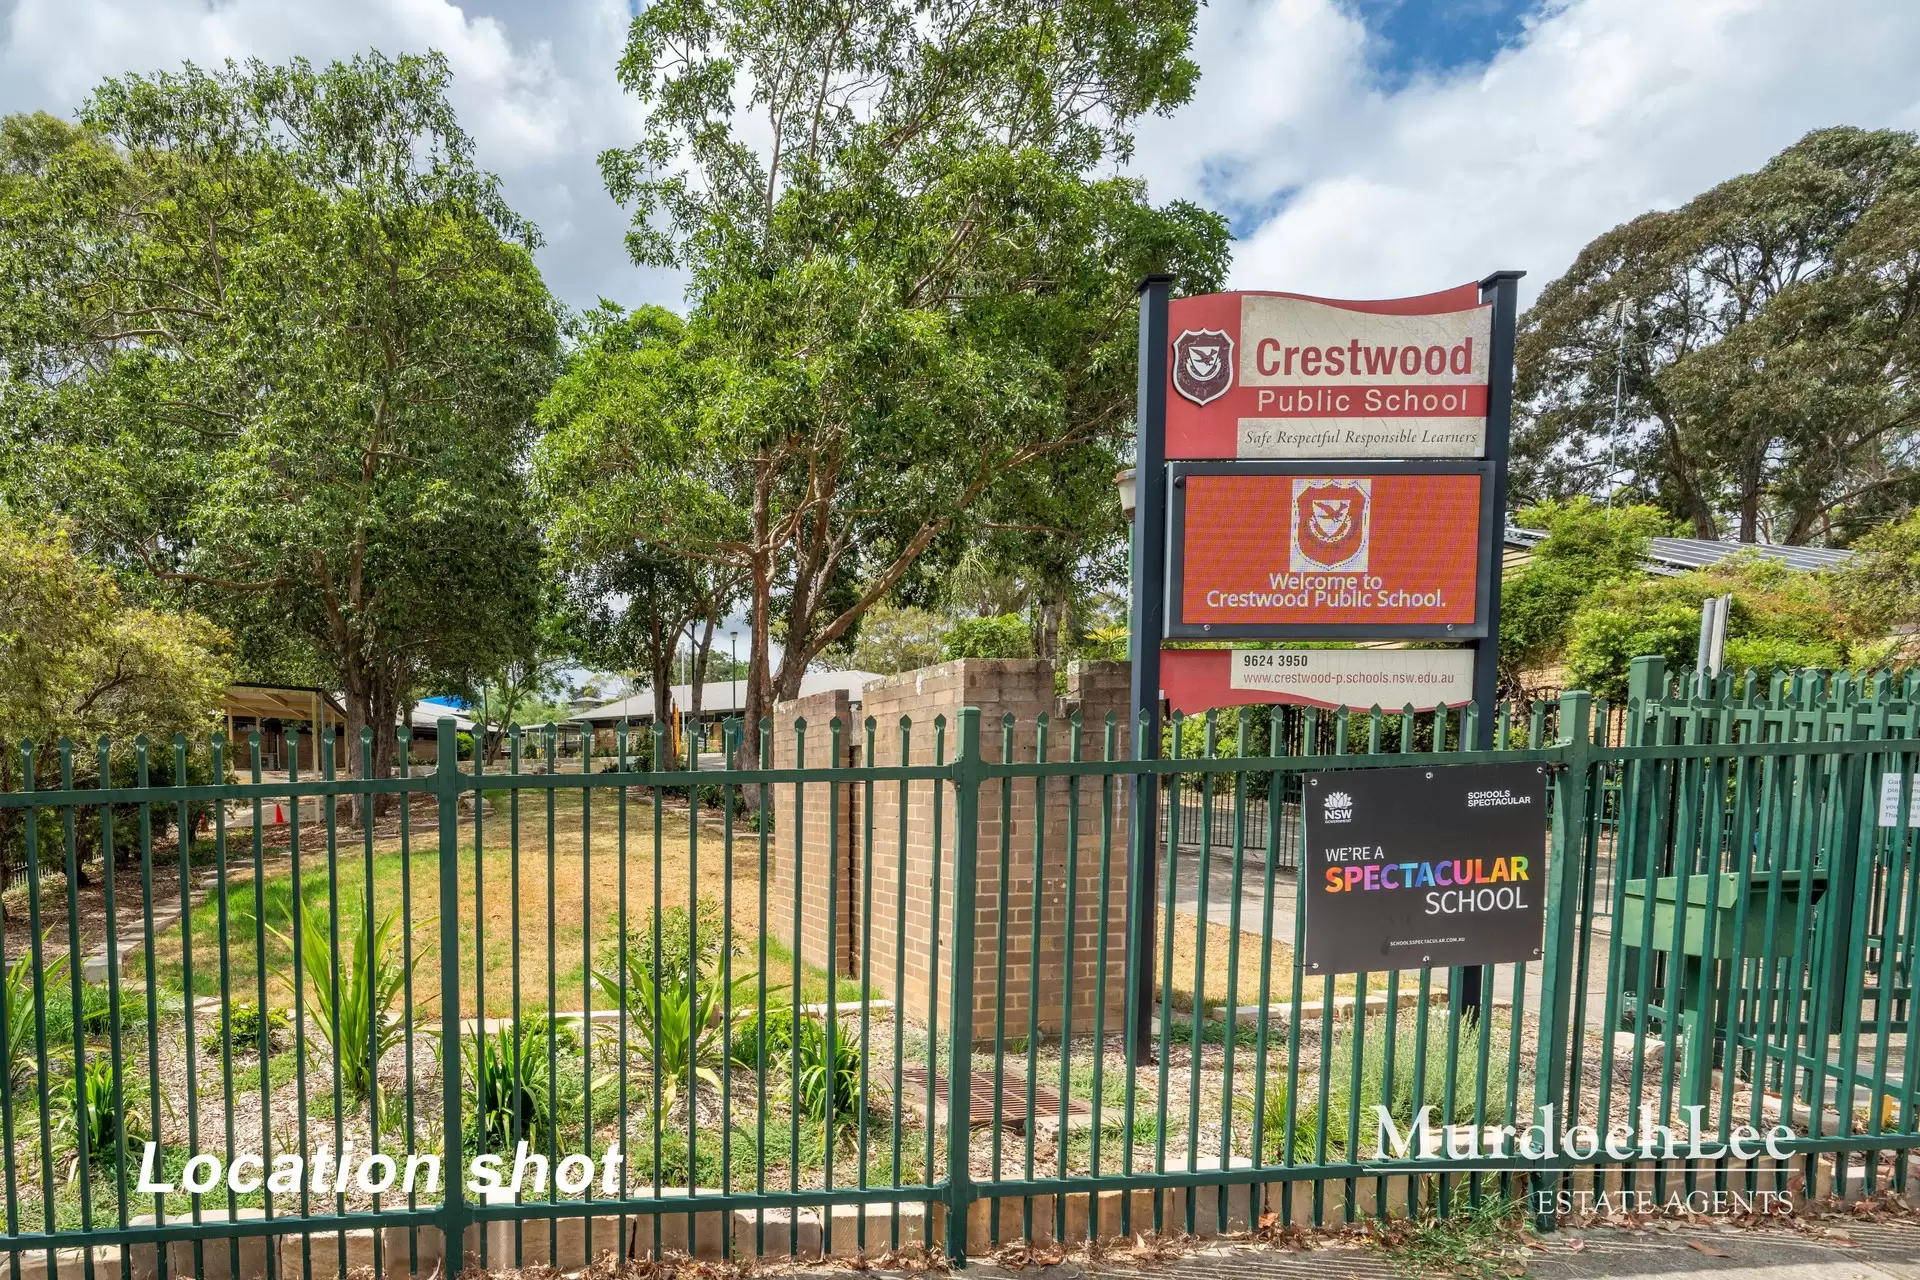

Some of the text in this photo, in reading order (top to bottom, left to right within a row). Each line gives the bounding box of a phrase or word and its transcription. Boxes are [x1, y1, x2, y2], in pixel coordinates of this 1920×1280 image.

[1256, 336, 1474, 376] Crestwood
[1258, 388, 1468, 412] Public School
[1245, 429, 1477, 445] Safe Respectful Responsible Learners
[1269, 572, 1383, 590] Welcome to
[1206, 588, 1446, 608] Crestwood Public School.
[1243, 655, 1308, 667] 9624 3950
[1243, 671, 1454, 686] www.crestwood-p.schools.nsw.edu.au
[1467, 789, 1511, 799] SCHOOLS
[1467, 796, 1531, 807] SPECTACULAR
[1324, 809, 1352, 820] NSW
[1374, 846, 1385, 860] A
[1325, 856, 1530, 893] SPECTACULAR
[1425, 886, 1529, 915] SCHOOL
